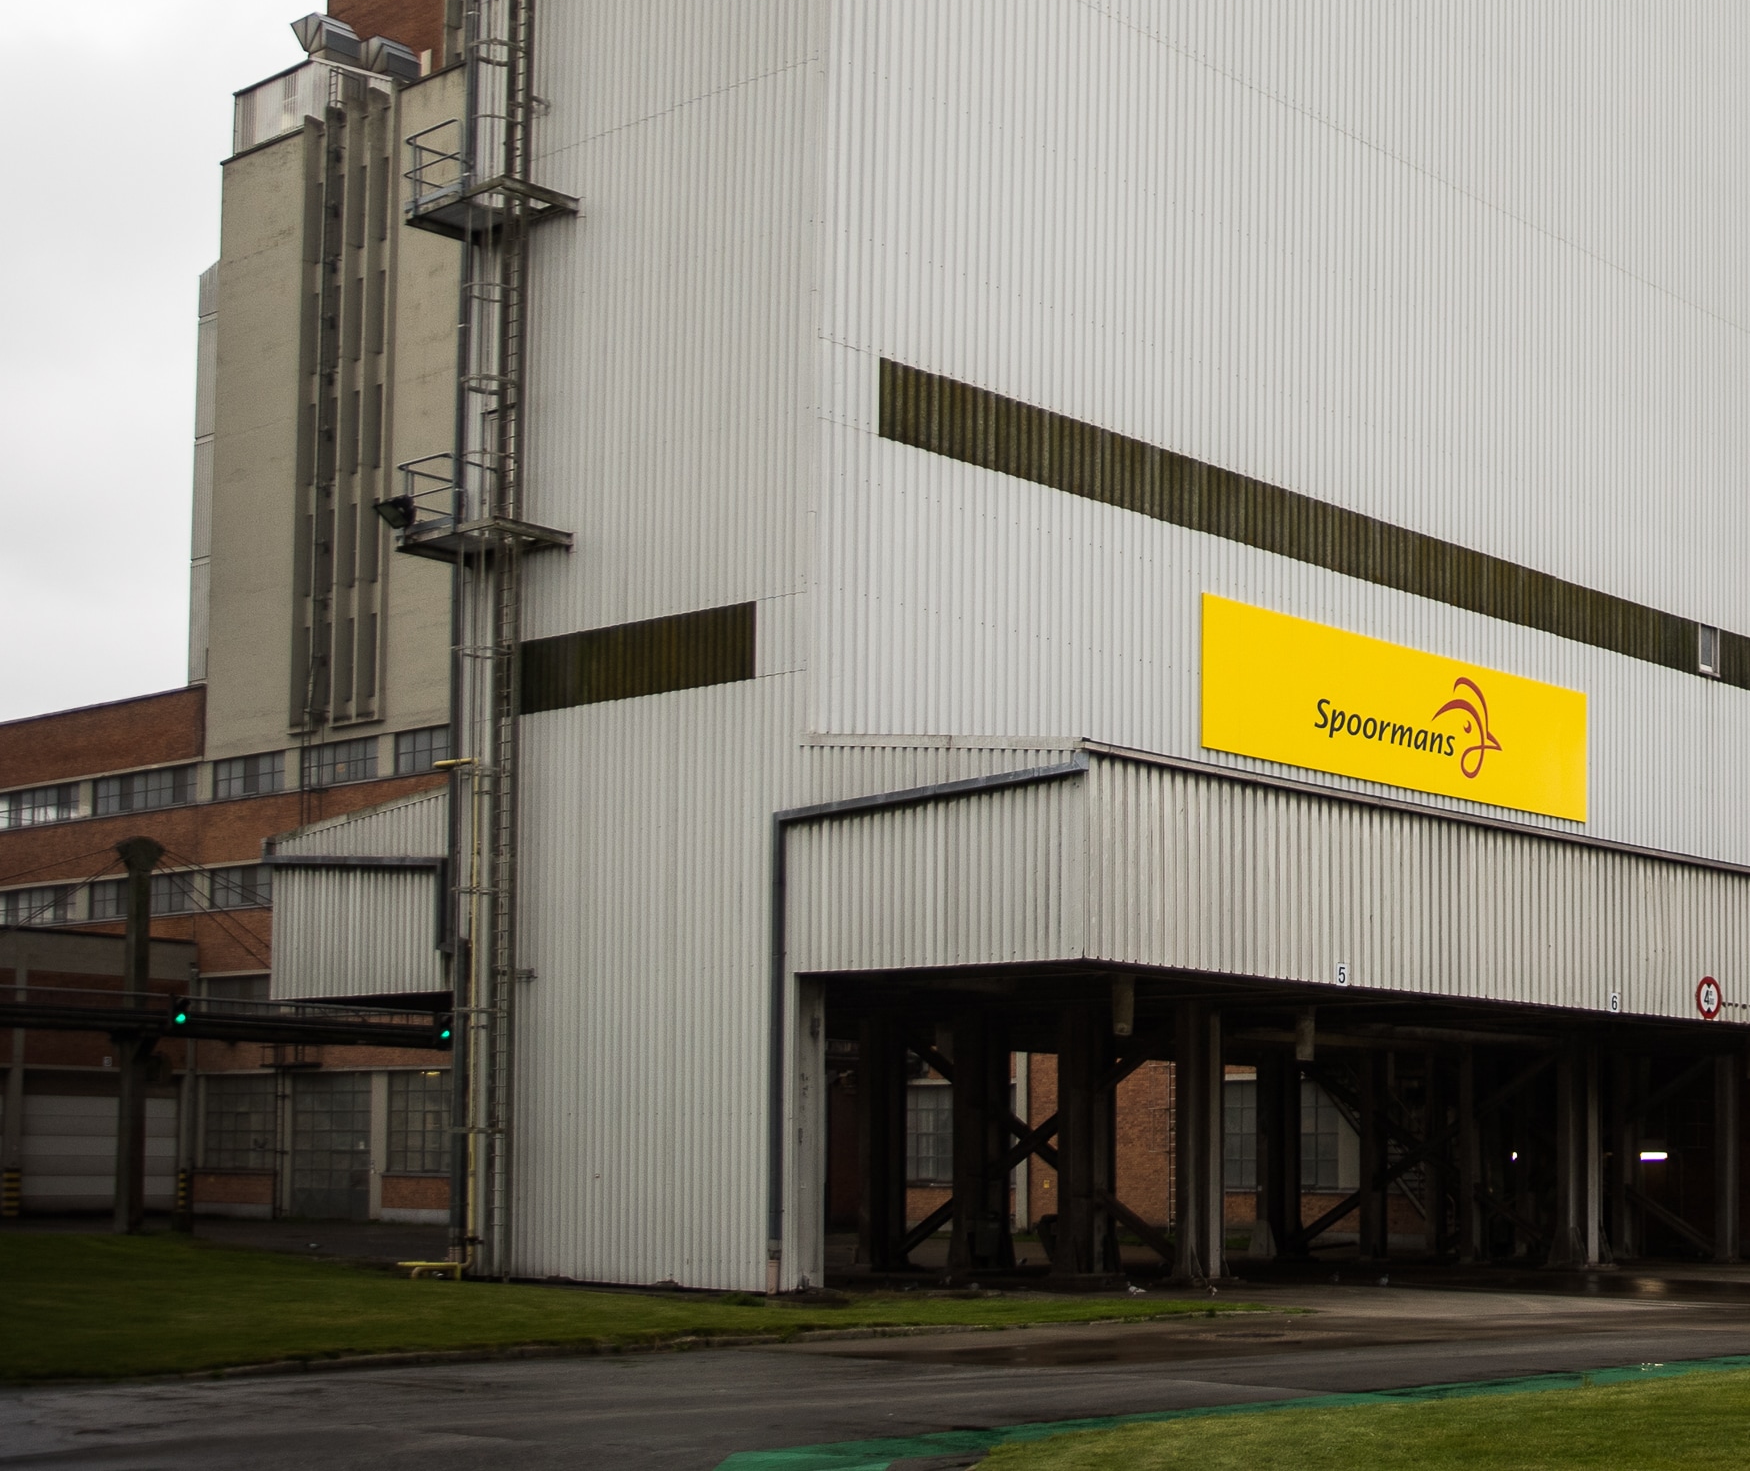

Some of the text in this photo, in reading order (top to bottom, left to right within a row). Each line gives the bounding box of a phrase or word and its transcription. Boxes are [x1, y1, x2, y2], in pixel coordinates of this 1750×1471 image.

[1314, 698, 1456, 757] Spoormans
[1338, 966, 1346, 984] 5
[1611, 995, 1618, 1010] 6
